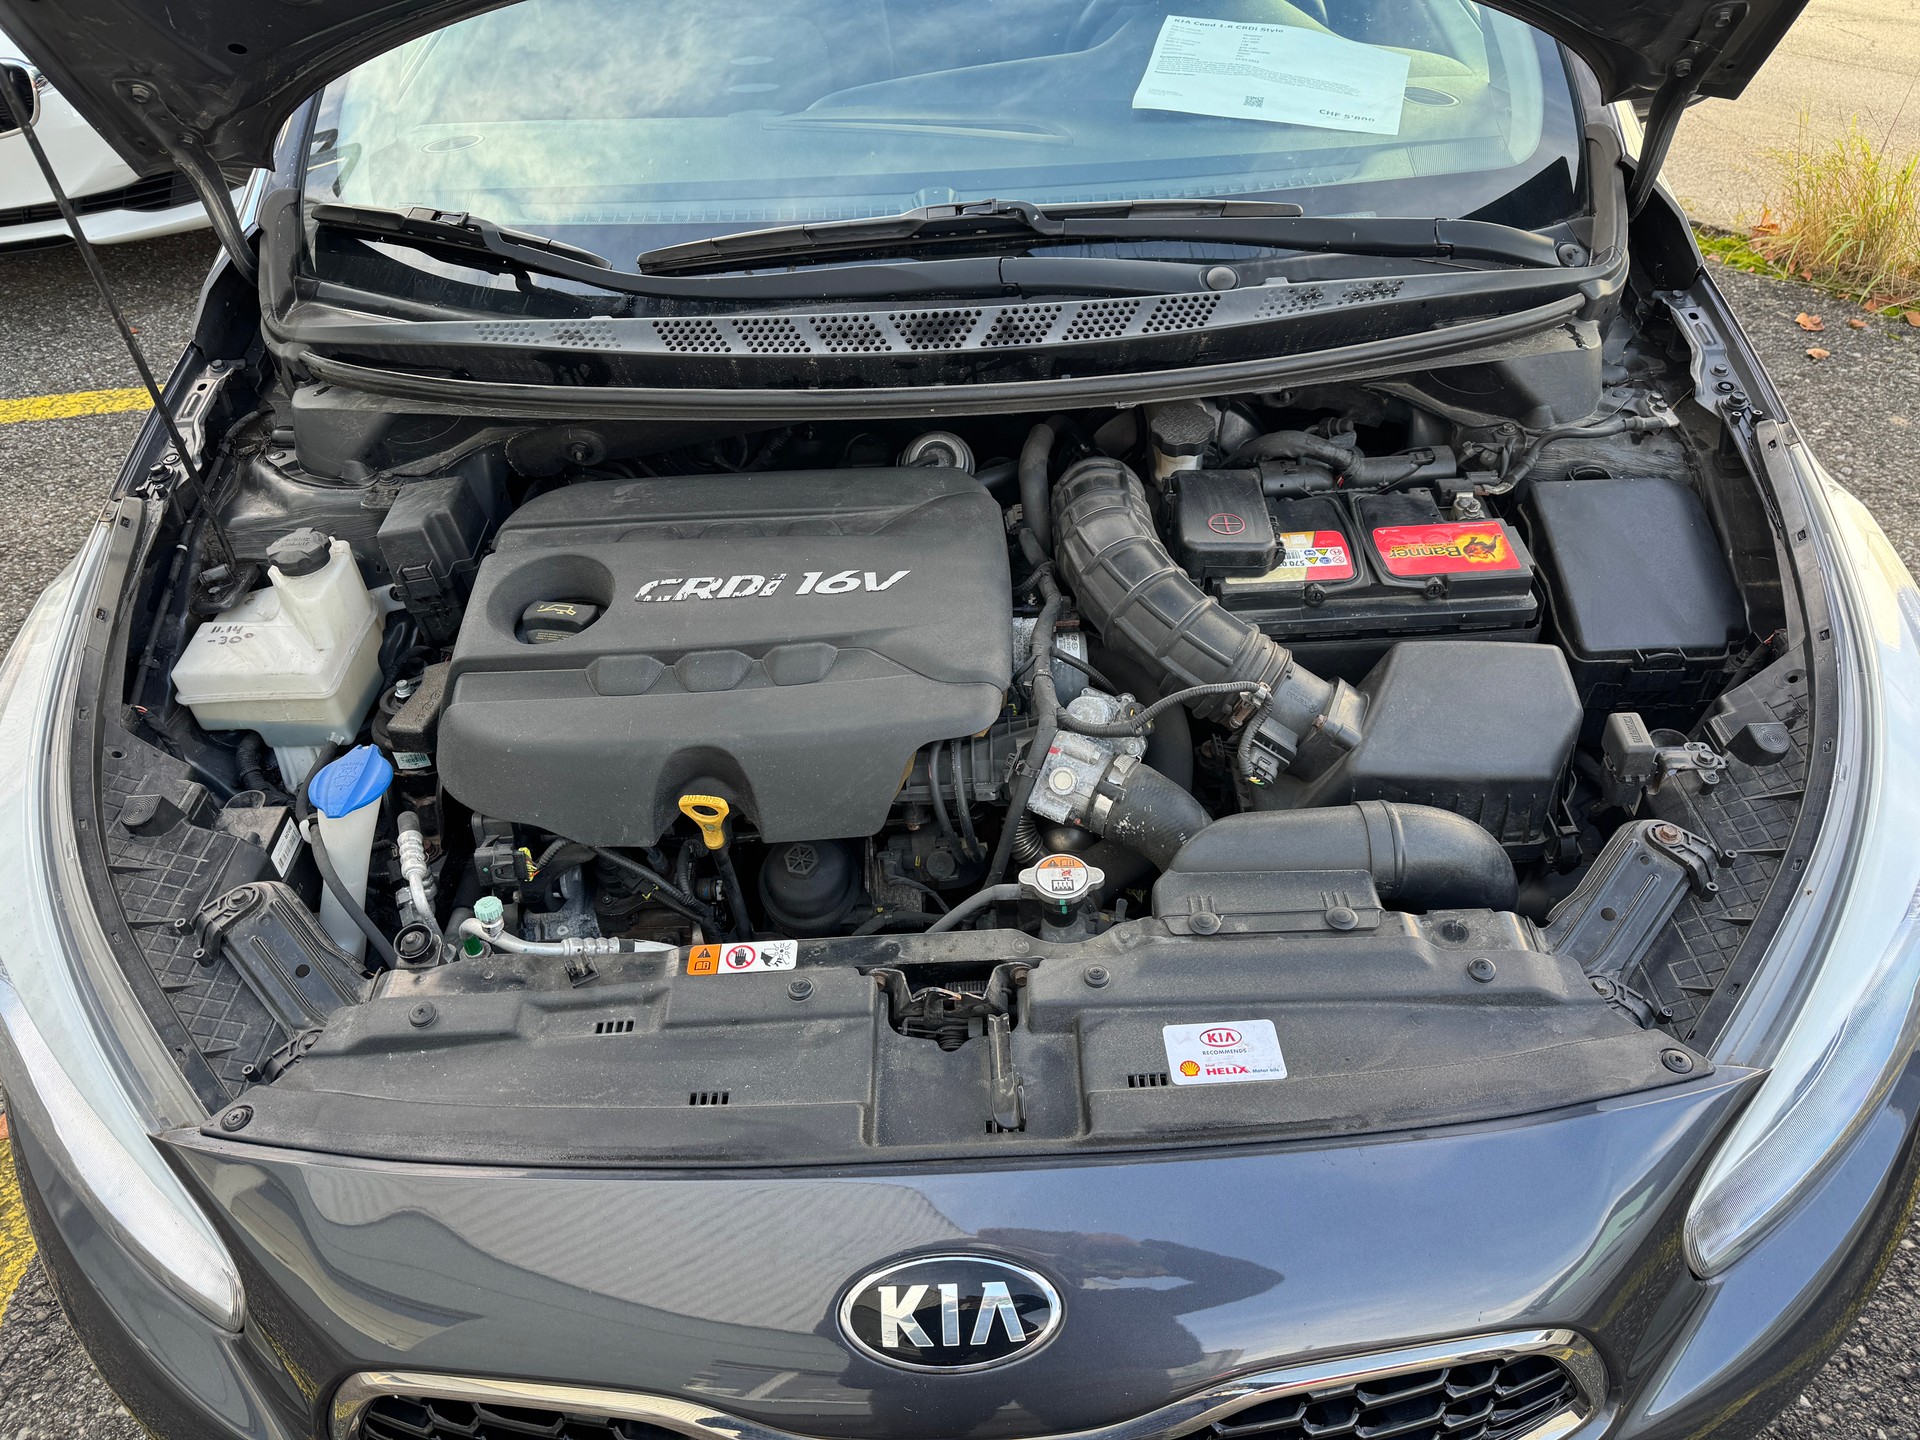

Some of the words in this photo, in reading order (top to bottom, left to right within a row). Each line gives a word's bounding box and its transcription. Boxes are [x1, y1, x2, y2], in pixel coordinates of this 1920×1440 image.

[1174, 17, 1191, 25] KIA
[1235, 24, 1258, 32] CRDi
[1260, 26, 1284, 34] Style
[1319, 108, 1341, 118] CHF
[1388, 545, 1463, 559] Banner
[1289, 559, 1305, 567] 570
[633, 572, 787, 603] CRDi
[795, 569, 911, 596] 16V
[1207, 1031, 1236, 1043] KIA
[1202, 1048, 1247, 1056] RECOMMENDS
[1206, 1066, 1249, 1076] HELIX
[877, 1281, 1027, 1348] KIA
